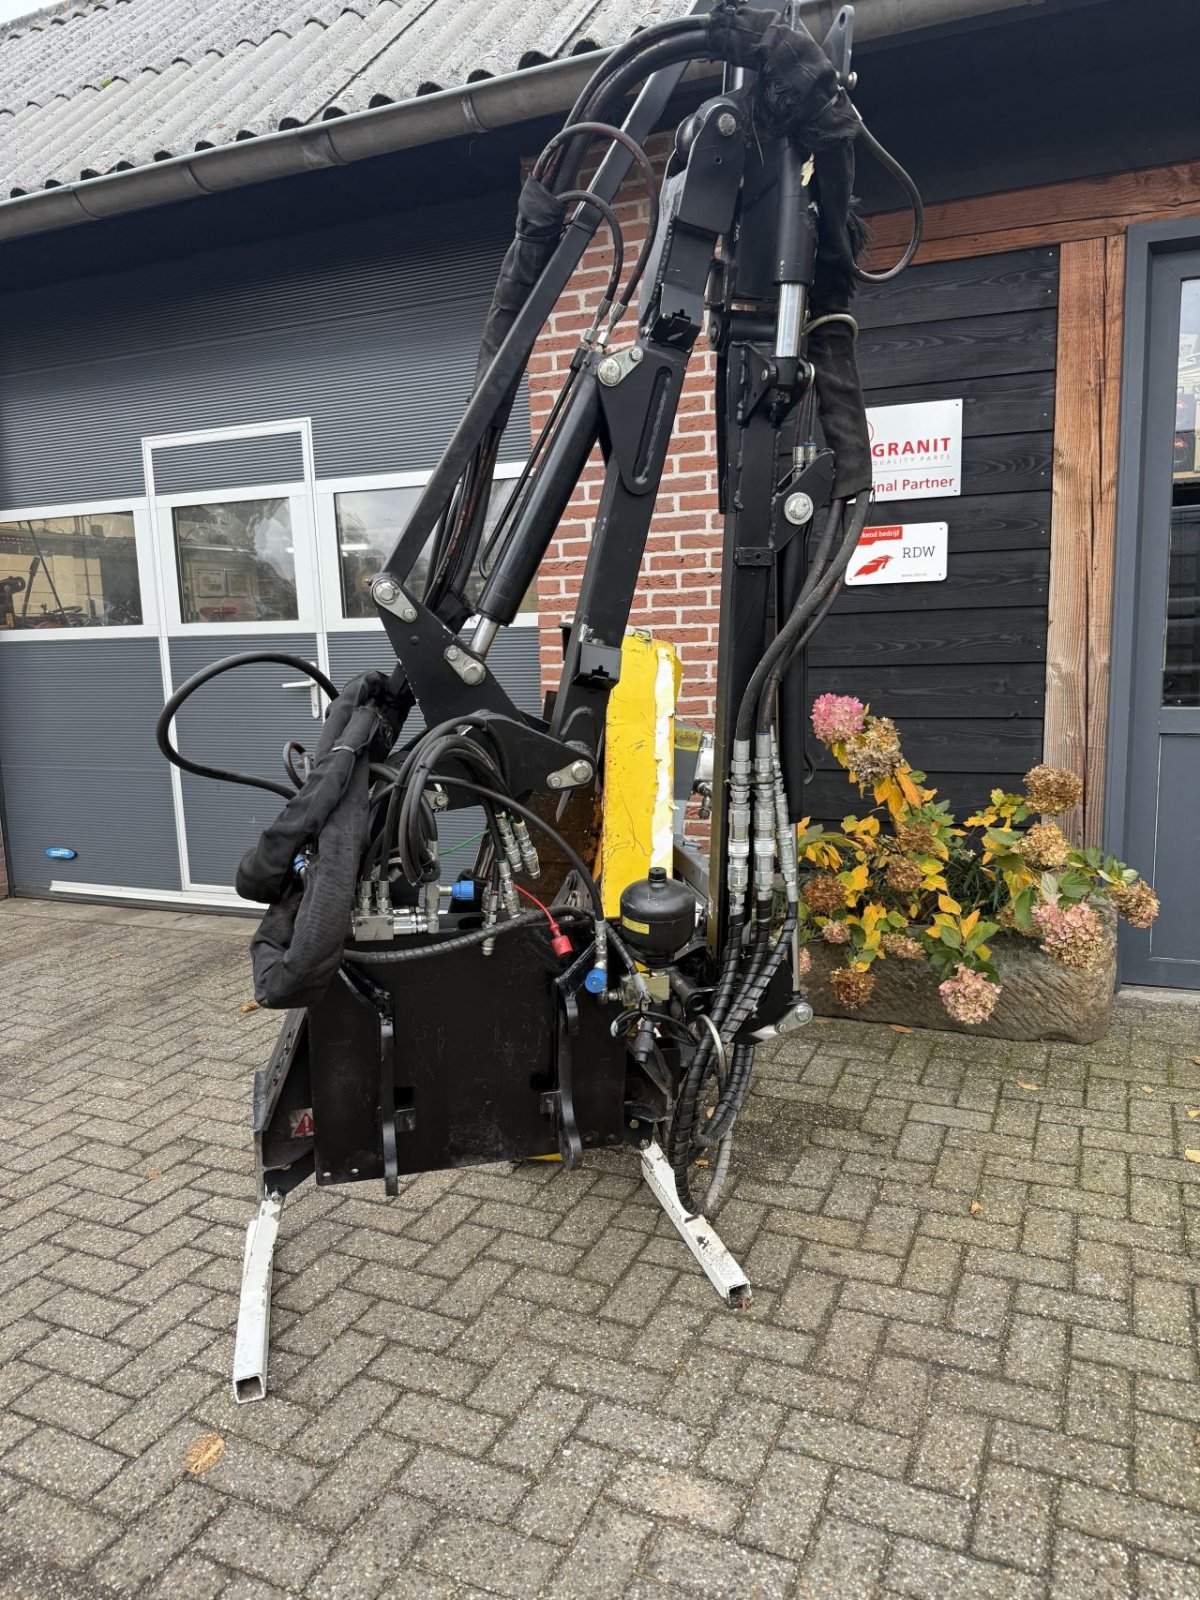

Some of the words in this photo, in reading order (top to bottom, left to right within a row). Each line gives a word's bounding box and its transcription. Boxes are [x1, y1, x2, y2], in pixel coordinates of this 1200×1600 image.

[872, 437, 951, 458] GRANIT
[873, 457, 915, 466] QUALITY
[921, 454, 951, 462] PARTS
[902, 477, 955, 491] Partner
[878, 529, 900, 538] bedrijf
[902, 545, 936, 559] RDW
